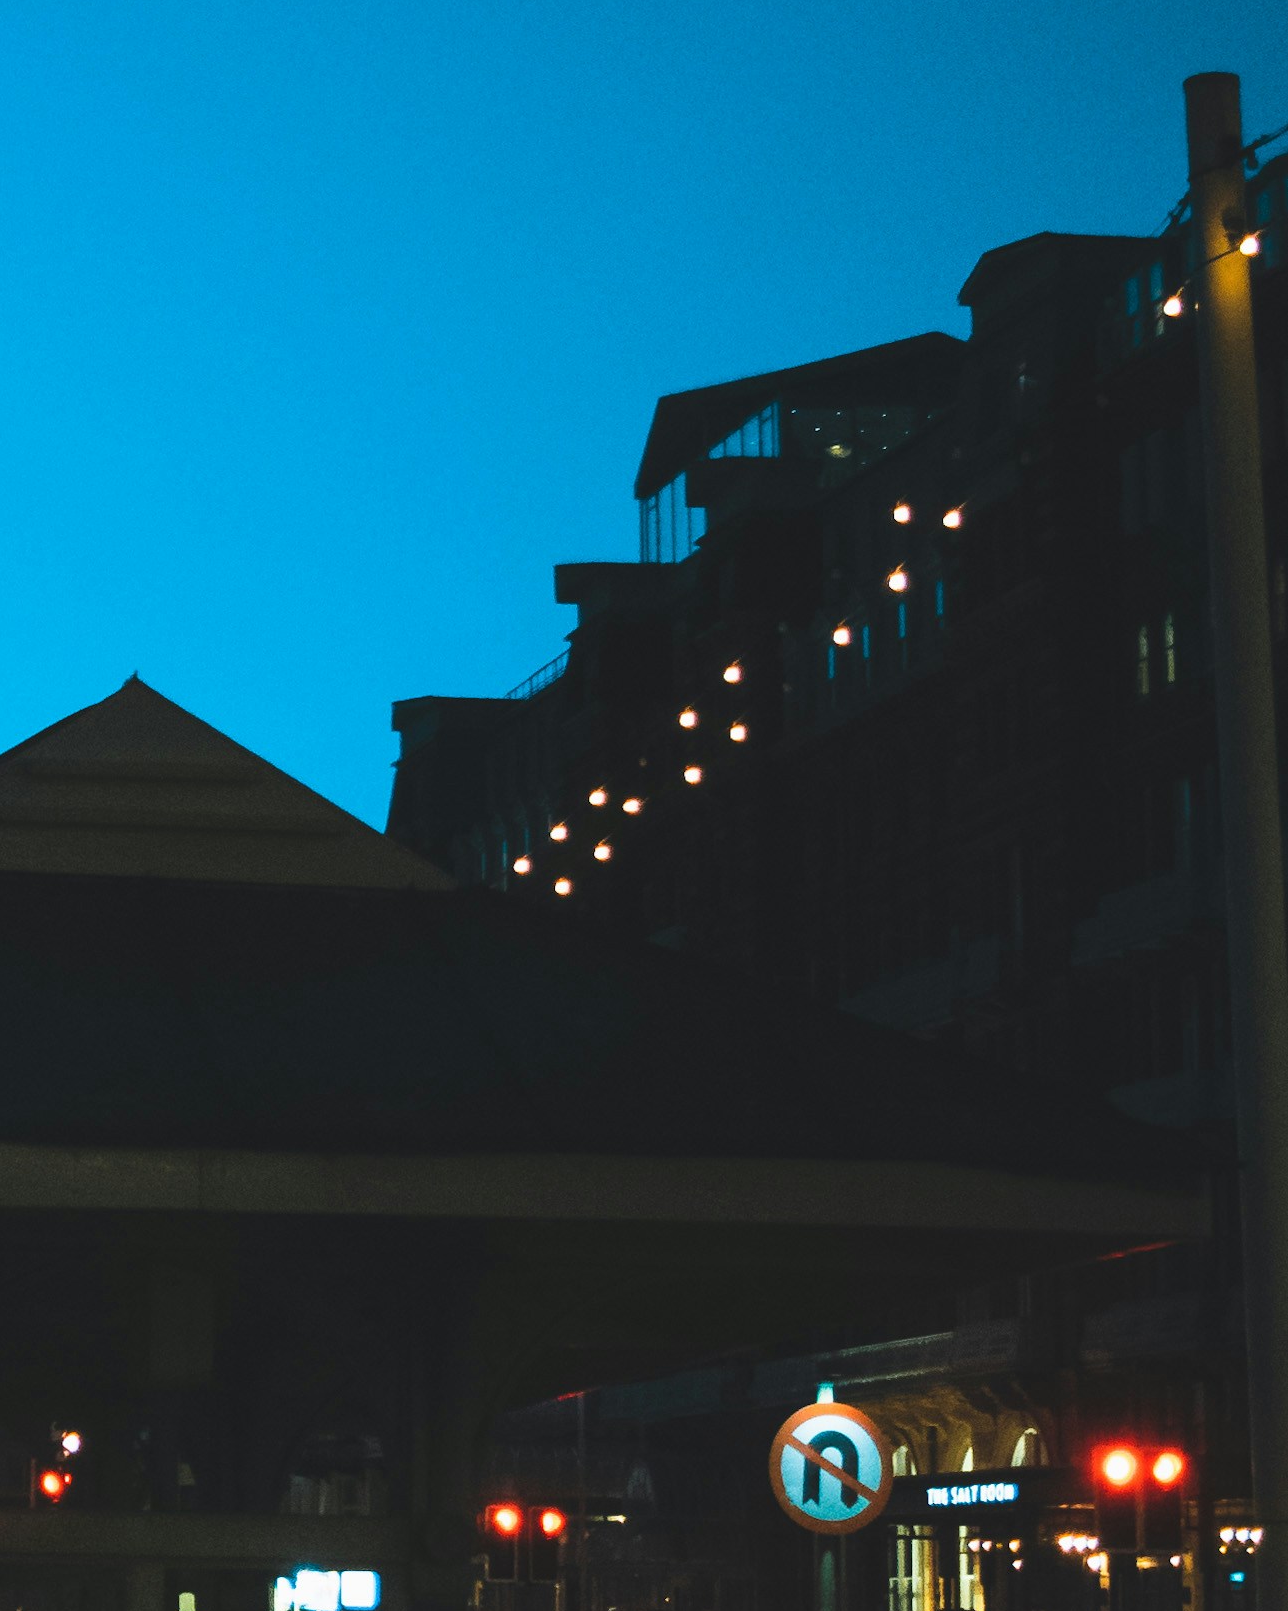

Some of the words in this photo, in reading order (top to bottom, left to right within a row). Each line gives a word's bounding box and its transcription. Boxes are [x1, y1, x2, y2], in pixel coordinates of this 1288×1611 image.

[927, 1487, 948, 1505] THE
[950, 1485, 979, 1504] SALT
[980, 1483, 1016, 1502] ROOM
